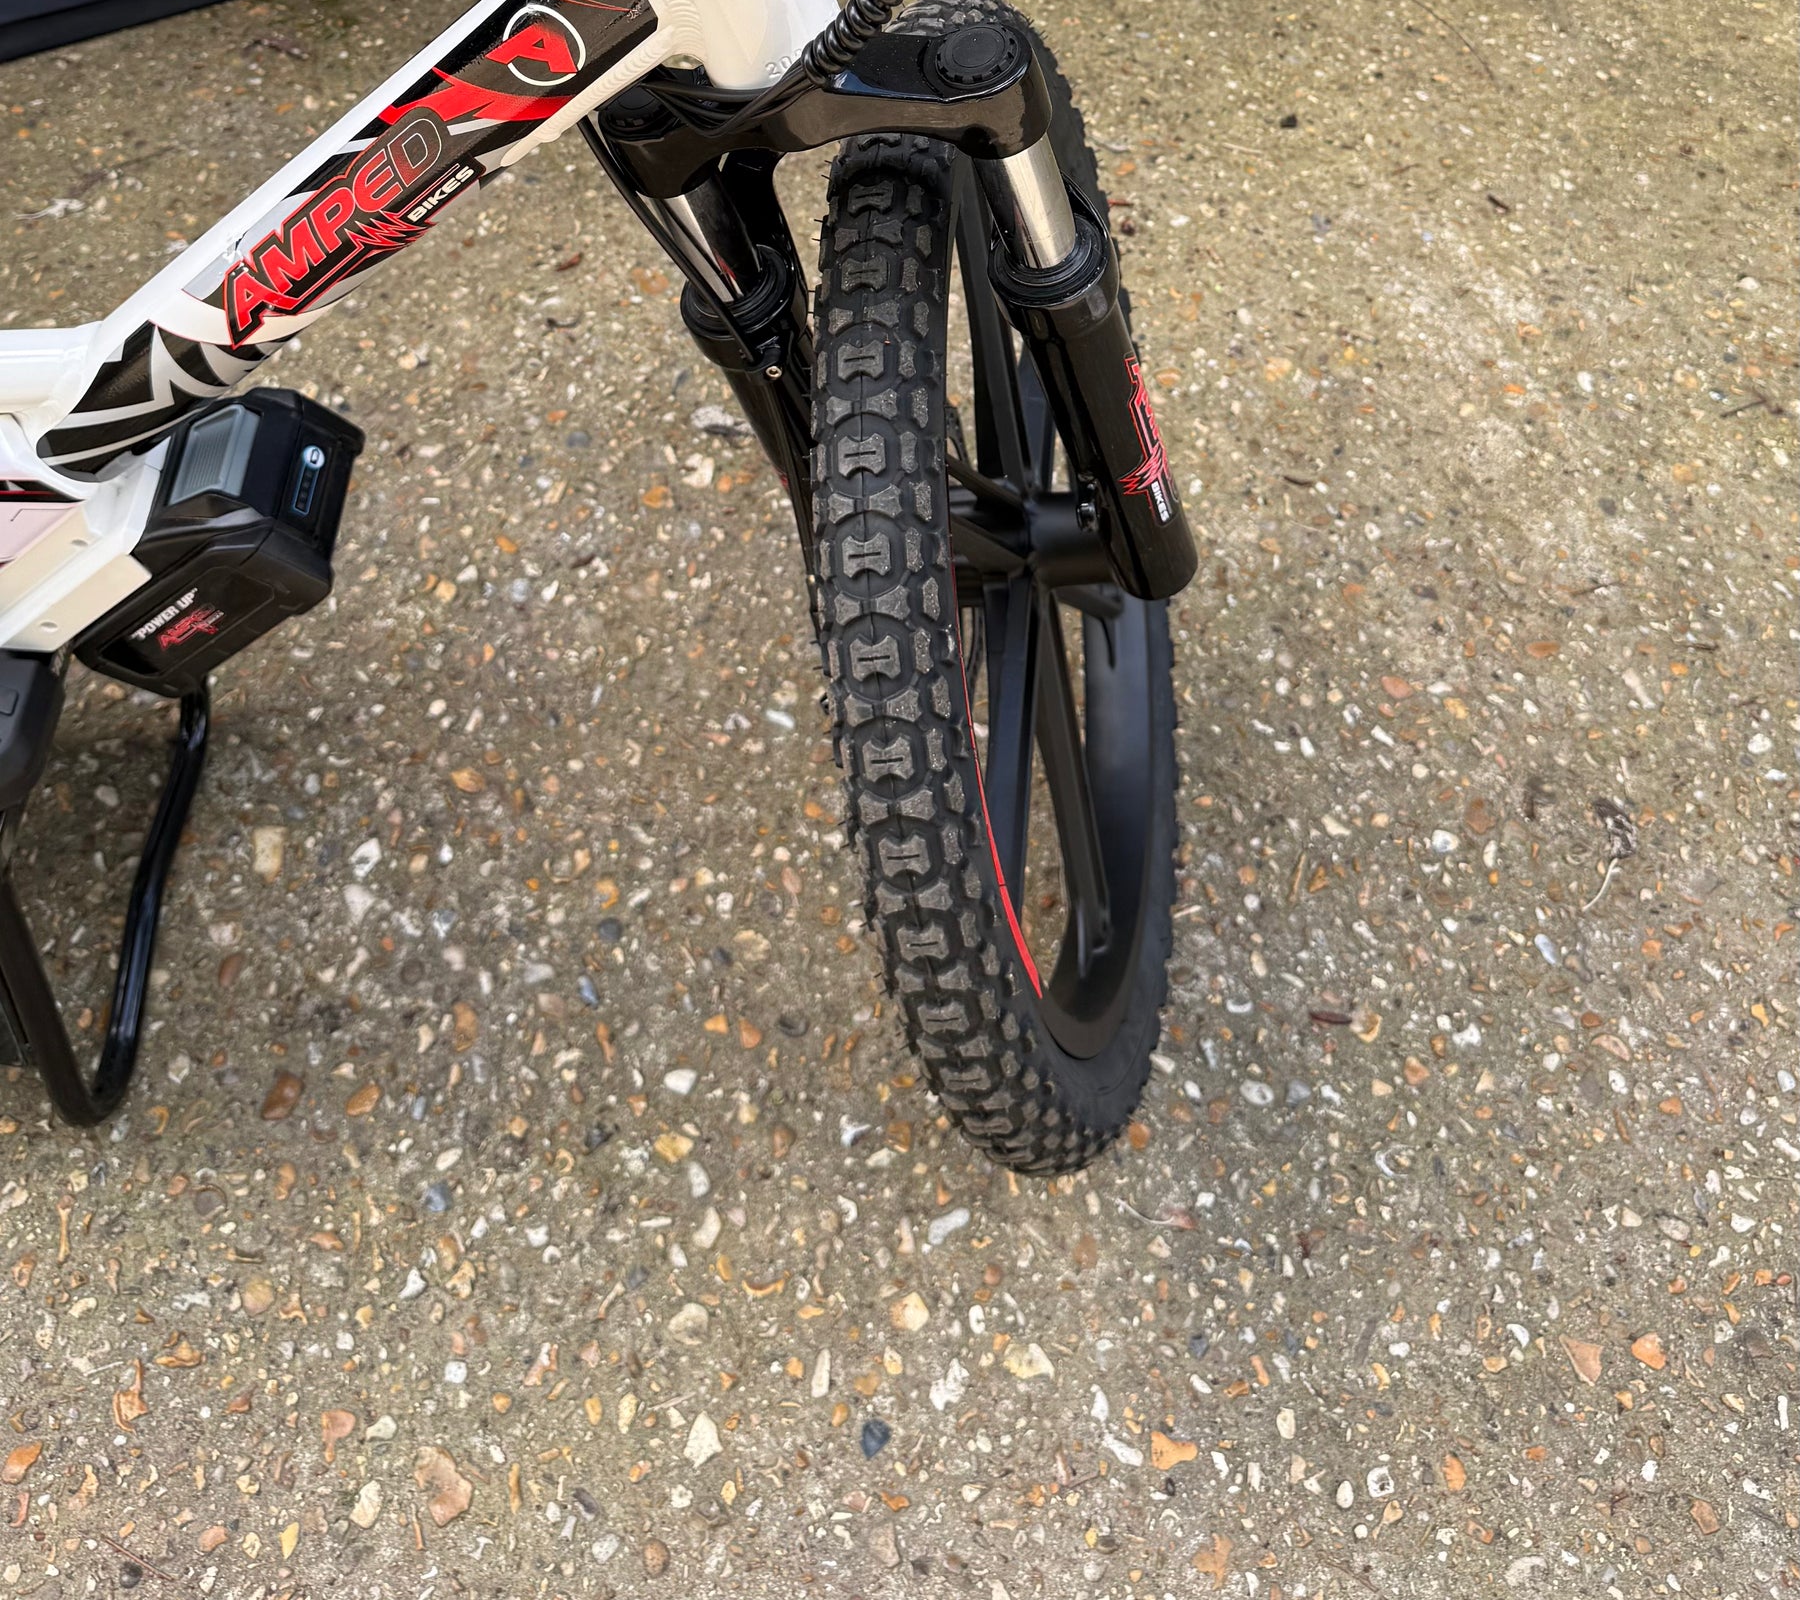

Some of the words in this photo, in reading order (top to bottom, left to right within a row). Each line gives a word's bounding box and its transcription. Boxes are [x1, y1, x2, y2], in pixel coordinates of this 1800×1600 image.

[486, 22, 578, 74] A
[406, 165, 474, 224] BIKES
[232, 117, 442, 332] AMPED
[1151, 481, 1169, 522] BIKES
